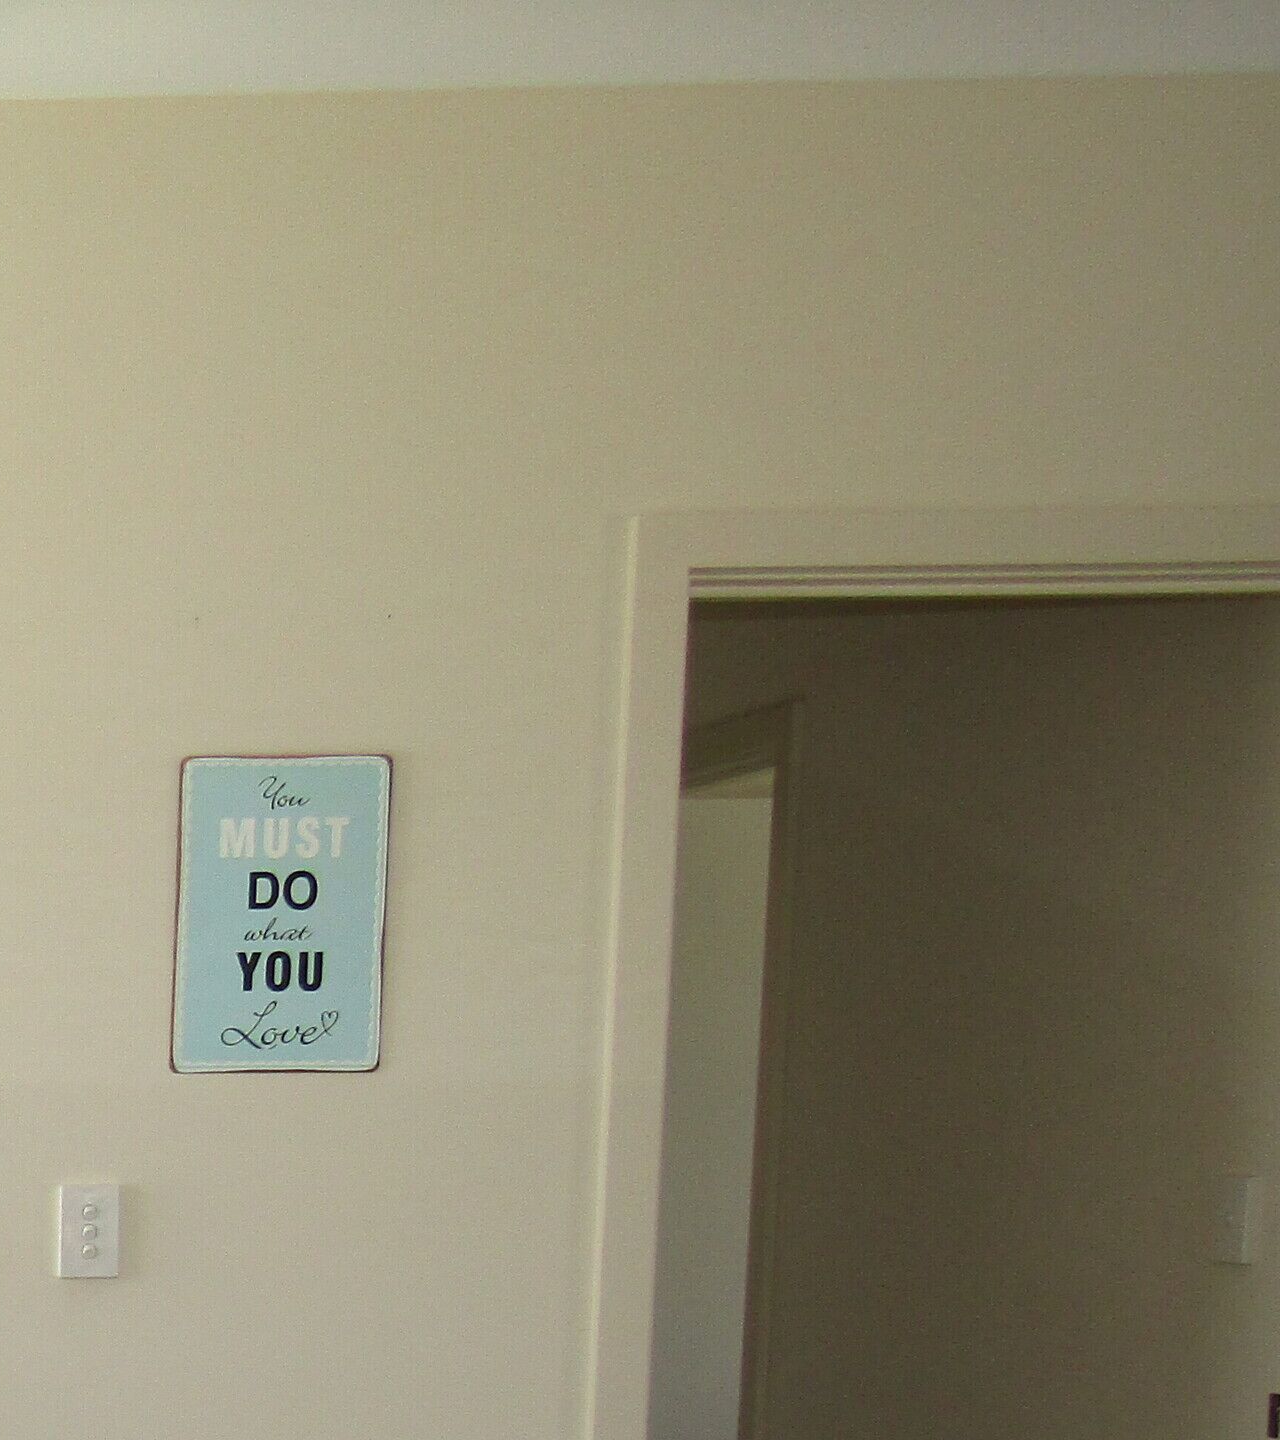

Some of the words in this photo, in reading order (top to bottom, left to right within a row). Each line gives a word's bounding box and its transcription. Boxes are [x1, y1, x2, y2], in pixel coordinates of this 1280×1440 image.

[258, 776, 311, 810] You
[219, 817, 350, 860] MUST
[248, 870, 319, 911] DO
[243, 917, 313, 942] what
[236, 951, 324, 993] YOU
[220, 1001, 324, 1050] Love
